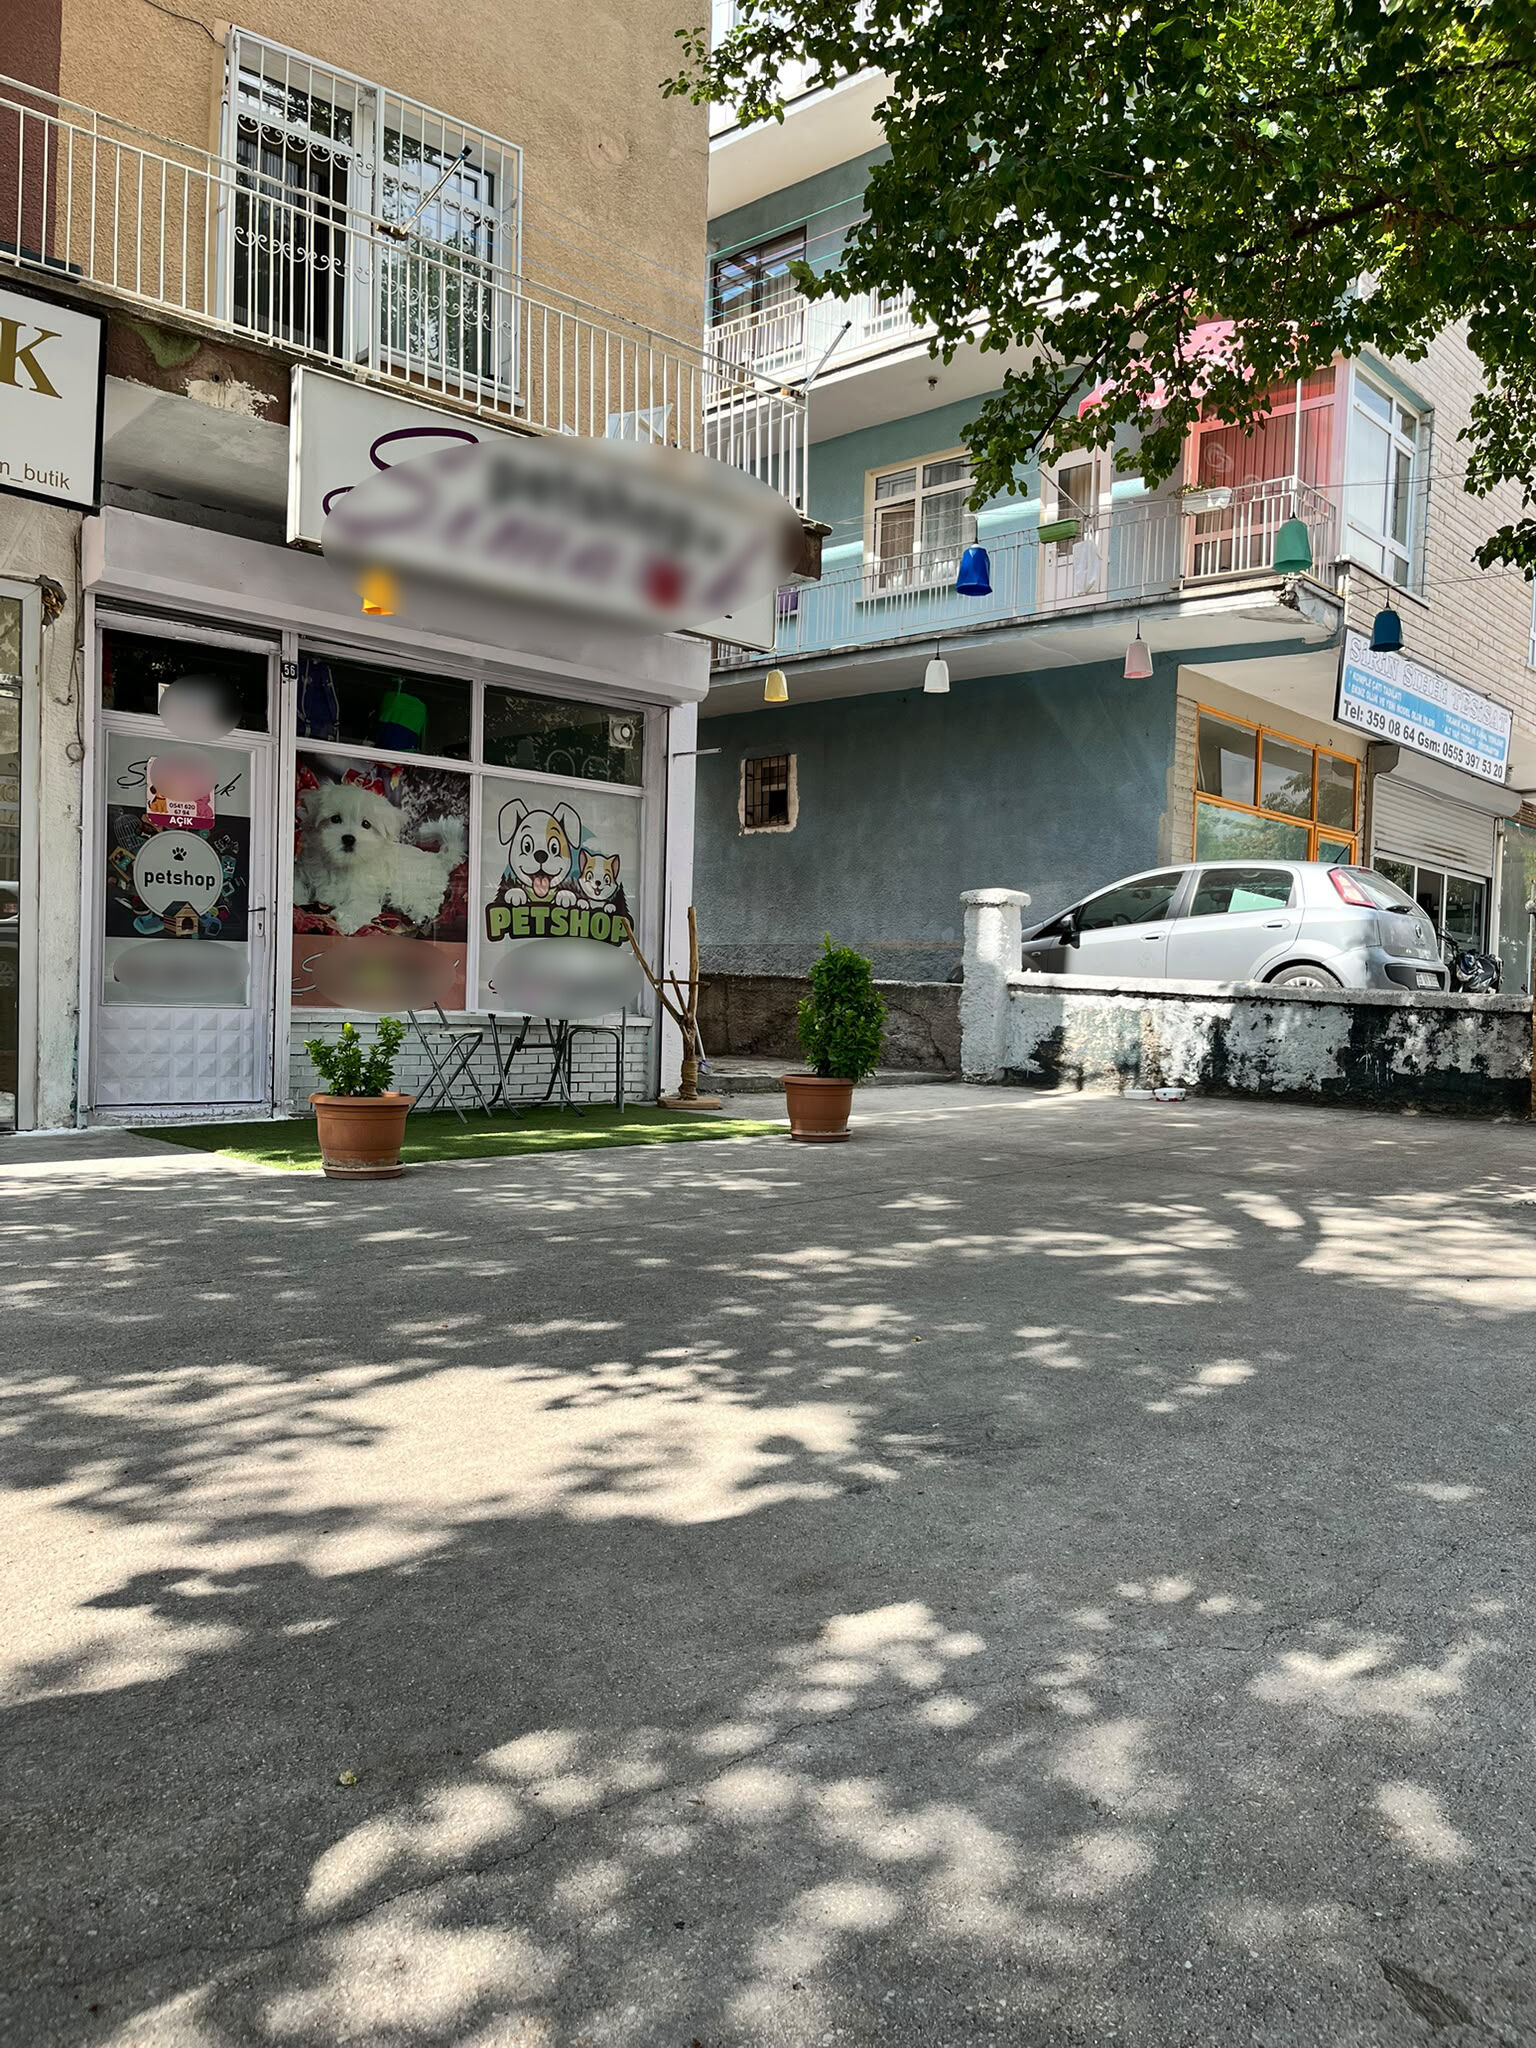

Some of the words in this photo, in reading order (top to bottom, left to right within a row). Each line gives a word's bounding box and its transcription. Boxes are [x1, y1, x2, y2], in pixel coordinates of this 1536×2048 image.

[284, 664, 295, 676] 56
[1343, 699, 1363, 722] Tel:
[1366, 709, 1385, 731] 359
[1388, 718, 1401, 737] 08
[1403, 724, 1415, 743] 64
[1417, 730, 1440, 753] Gsm:
[1442, 741, 1463, 763] 0555
[1465, 751, 1479, 769] 397
[1481, 758, 1491, 774] 53
[1493, 763, 1502, 778] 20
[144, 870, 215, 890] petshop
[489, 906, 630, 942] PETSHOP
